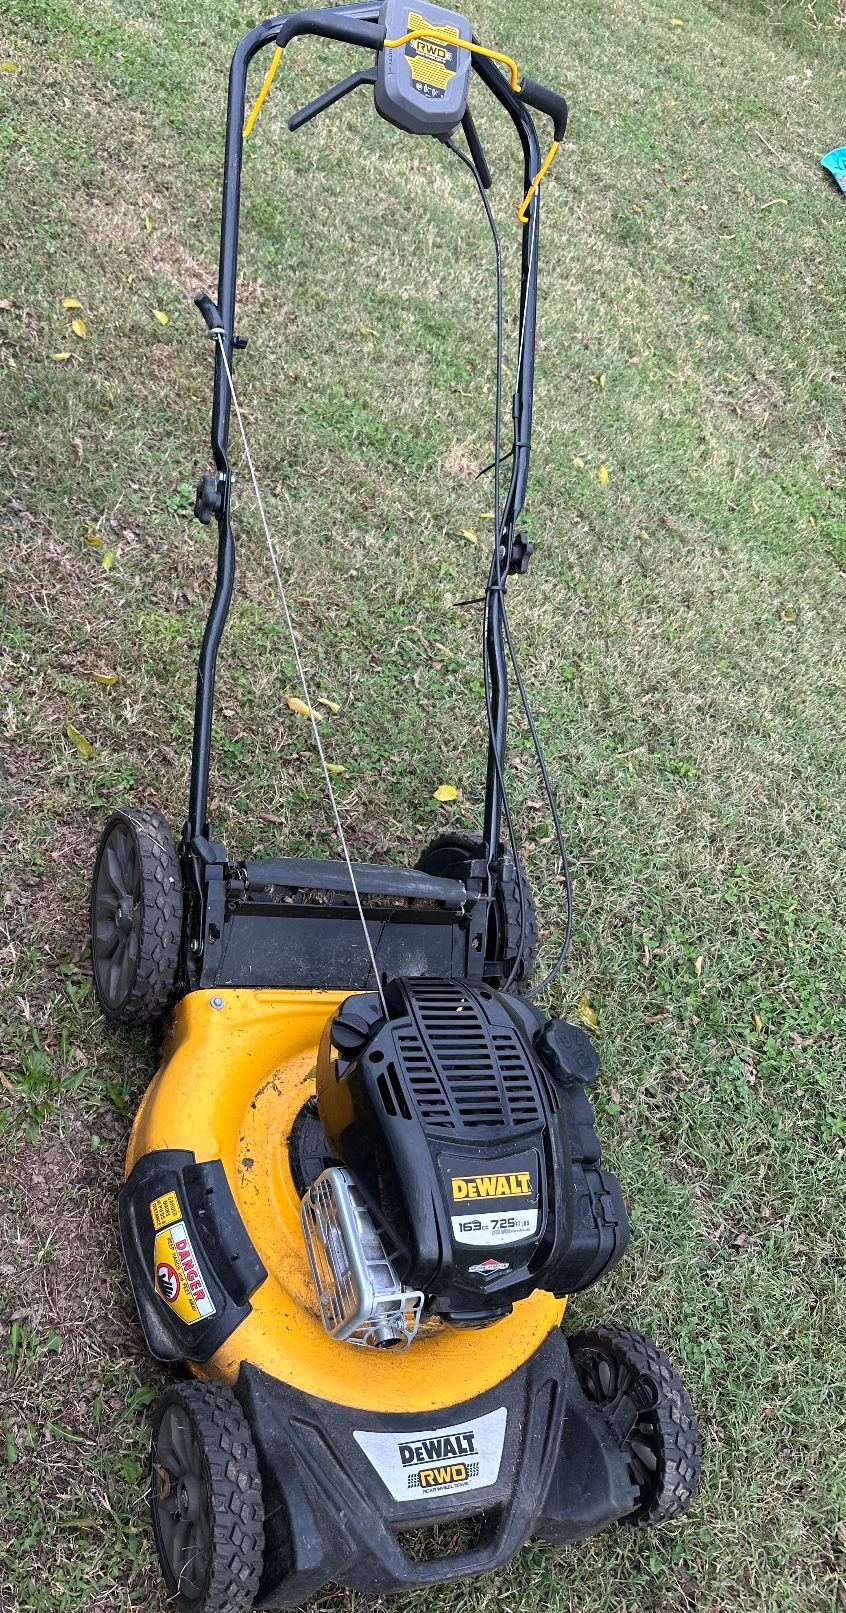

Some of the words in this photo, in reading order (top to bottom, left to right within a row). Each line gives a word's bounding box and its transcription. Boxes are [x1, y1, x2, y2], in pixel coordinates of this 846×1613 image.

[416, 41, 446, 58] RWD
[175, 1239, 205, 1302] DANGER
[419, 1464, 467, 1487] RWD
